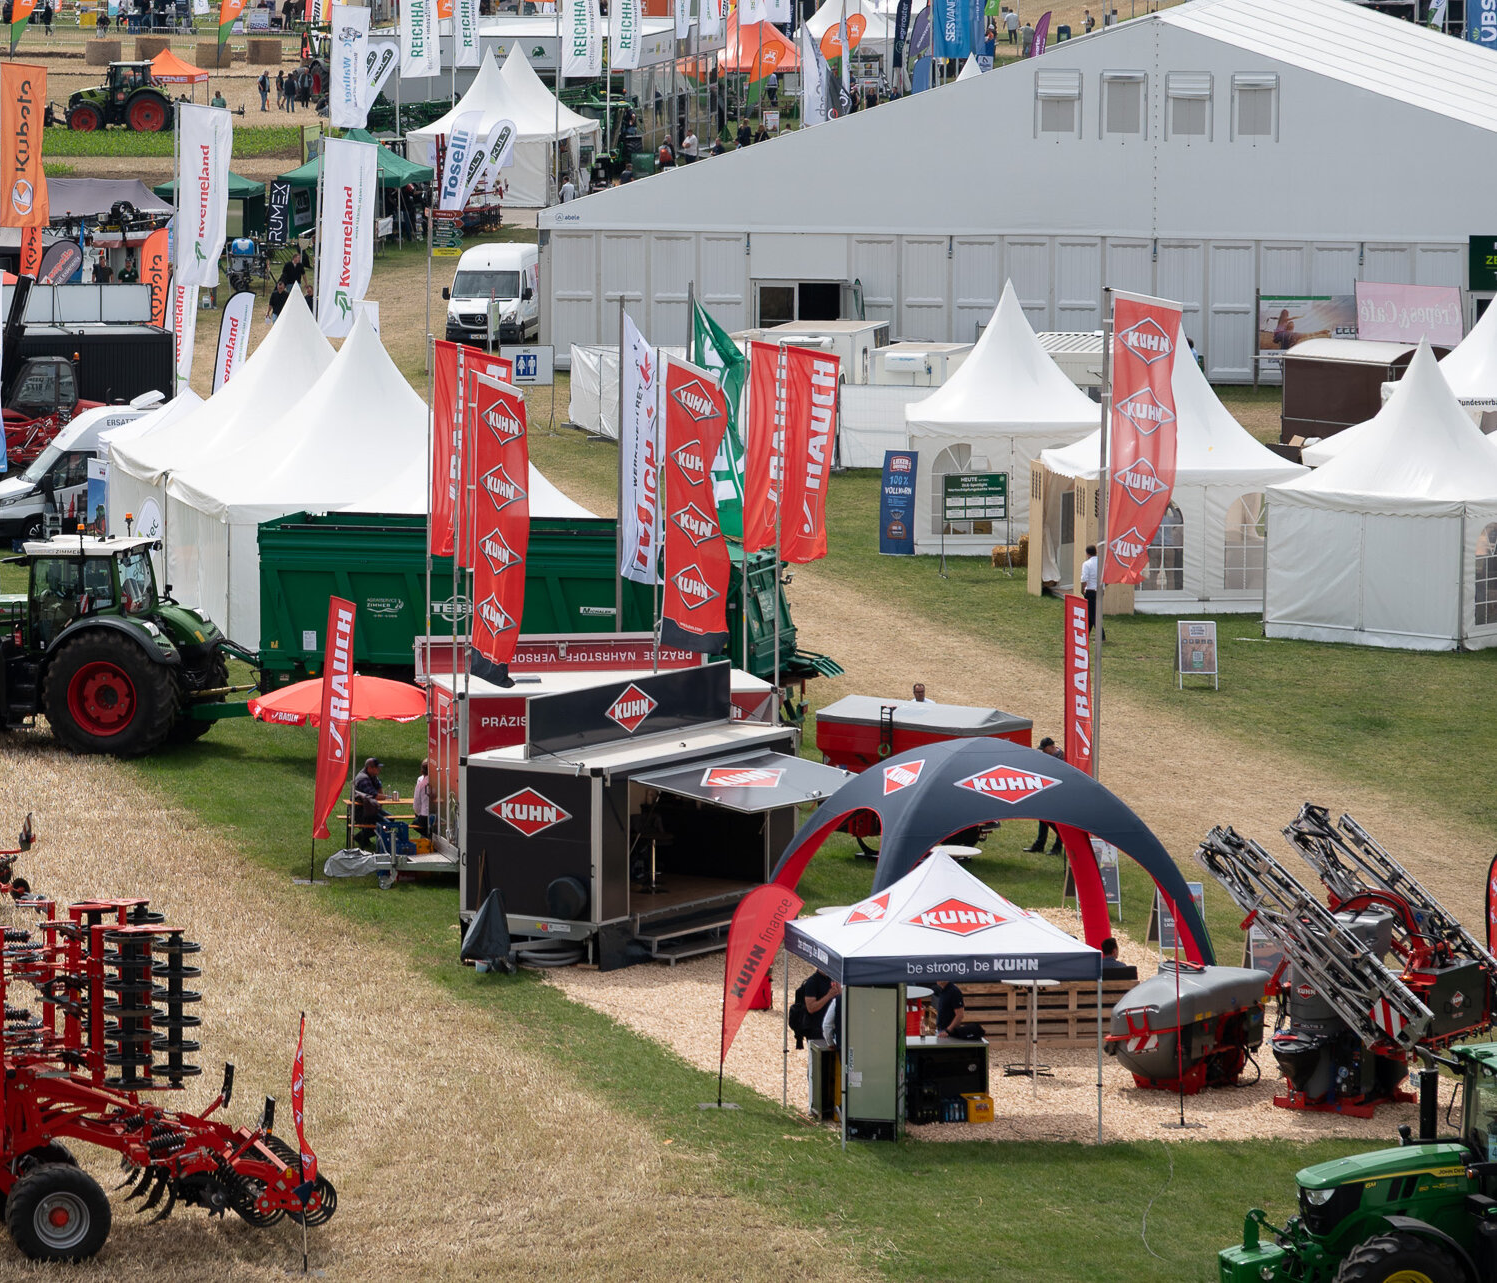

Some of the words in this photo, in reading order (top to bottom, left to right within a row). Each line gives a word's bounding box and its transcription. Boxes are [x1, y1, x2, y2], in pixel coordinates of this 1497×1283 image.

[15, 80, 32, 172] Kubota
[443, 130, 469, 200] Toselli
[339, 186, 353, 287] Kverneland
[1127, 330, 1170, 354] KUHN
[680, 389, 713, 416] KUHN
[1127, 401, 1163, 423] KUHN
[488, 410, 520, 435] KUHN
[678, 450, 704, 472] KUH
[486, 474, 515, 500] KUHN
[485, 539, 512, 565] KUHN
[675, 574, 708, 599] KUHN
[330, 608, 353, 720] RAUCH
[643, 650, 693, 661] PRÄZISE
[1073, 605, 1088, 718] RAUCH
[614, 699, 650, 720] KUHN
[714, 769, 773, 787] KUHN
[886, 764, 919, 795] KUHN
[972, 776, 1044, 791] KUHN
[502, 803, 557, 822] KUHN
[760, 898, 793, 943] finance
[856, 900, 890, 923] KUHN
[921, 910, 996, 926] KUHN
[729, 944, 766, 999] KUHN
[907, 961, 923, 974] be
[926, 961, 970, 978] strong,
[973, 960, 990, 973] be
[993, 958, 1039, 971] KUHN
[1297, 988, 1317, 997] KUHN
